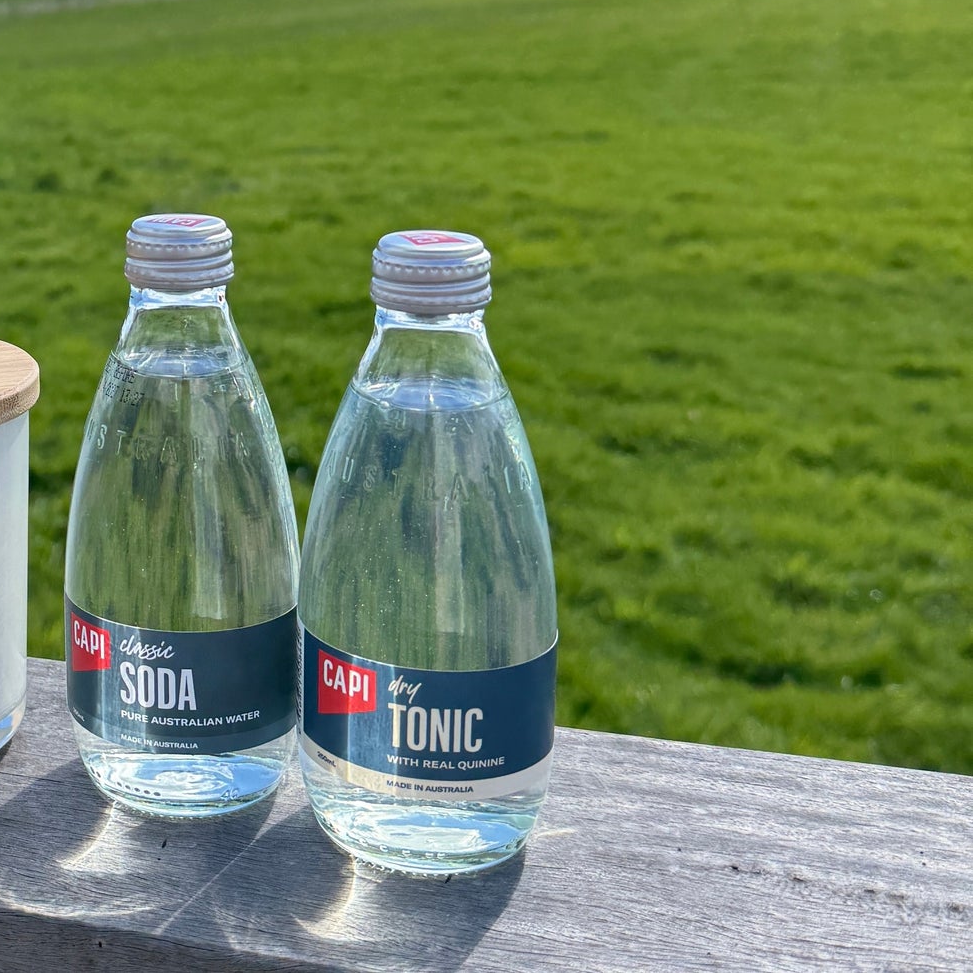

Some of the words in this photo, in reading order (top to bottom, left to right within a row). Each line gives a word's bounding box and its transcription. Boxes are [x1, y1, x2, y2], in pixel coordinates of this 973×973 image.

[73, 619, 106, 660] CAPI
[118, 634, 177, 661] classic
[118, 660, 198, 712] SODA
[322, 658, 370, 703] CAPI
[387, 675, 423, 704] dry
[120, 709, 149, 724] PURE
[150, 715, 224, 727] AUSTRALIAN
[225, 709, 261, 725] WATER
[387, 702, 484, 754] TONIC
[120, 733, 143, 745] MADE
[143, 737, 153, 747] IN
[153, 739, 199, 750] AUSTRALIA
[386, 754, 420, 768] WITH
[422, 759, 457, 771] REAL
[457, 756, 506, 772] QUININE
[386, 779, 413, 791] MADE
[413, 783, 424, 793] IN
[424, 784, 475, 794] AUSTRALIA
